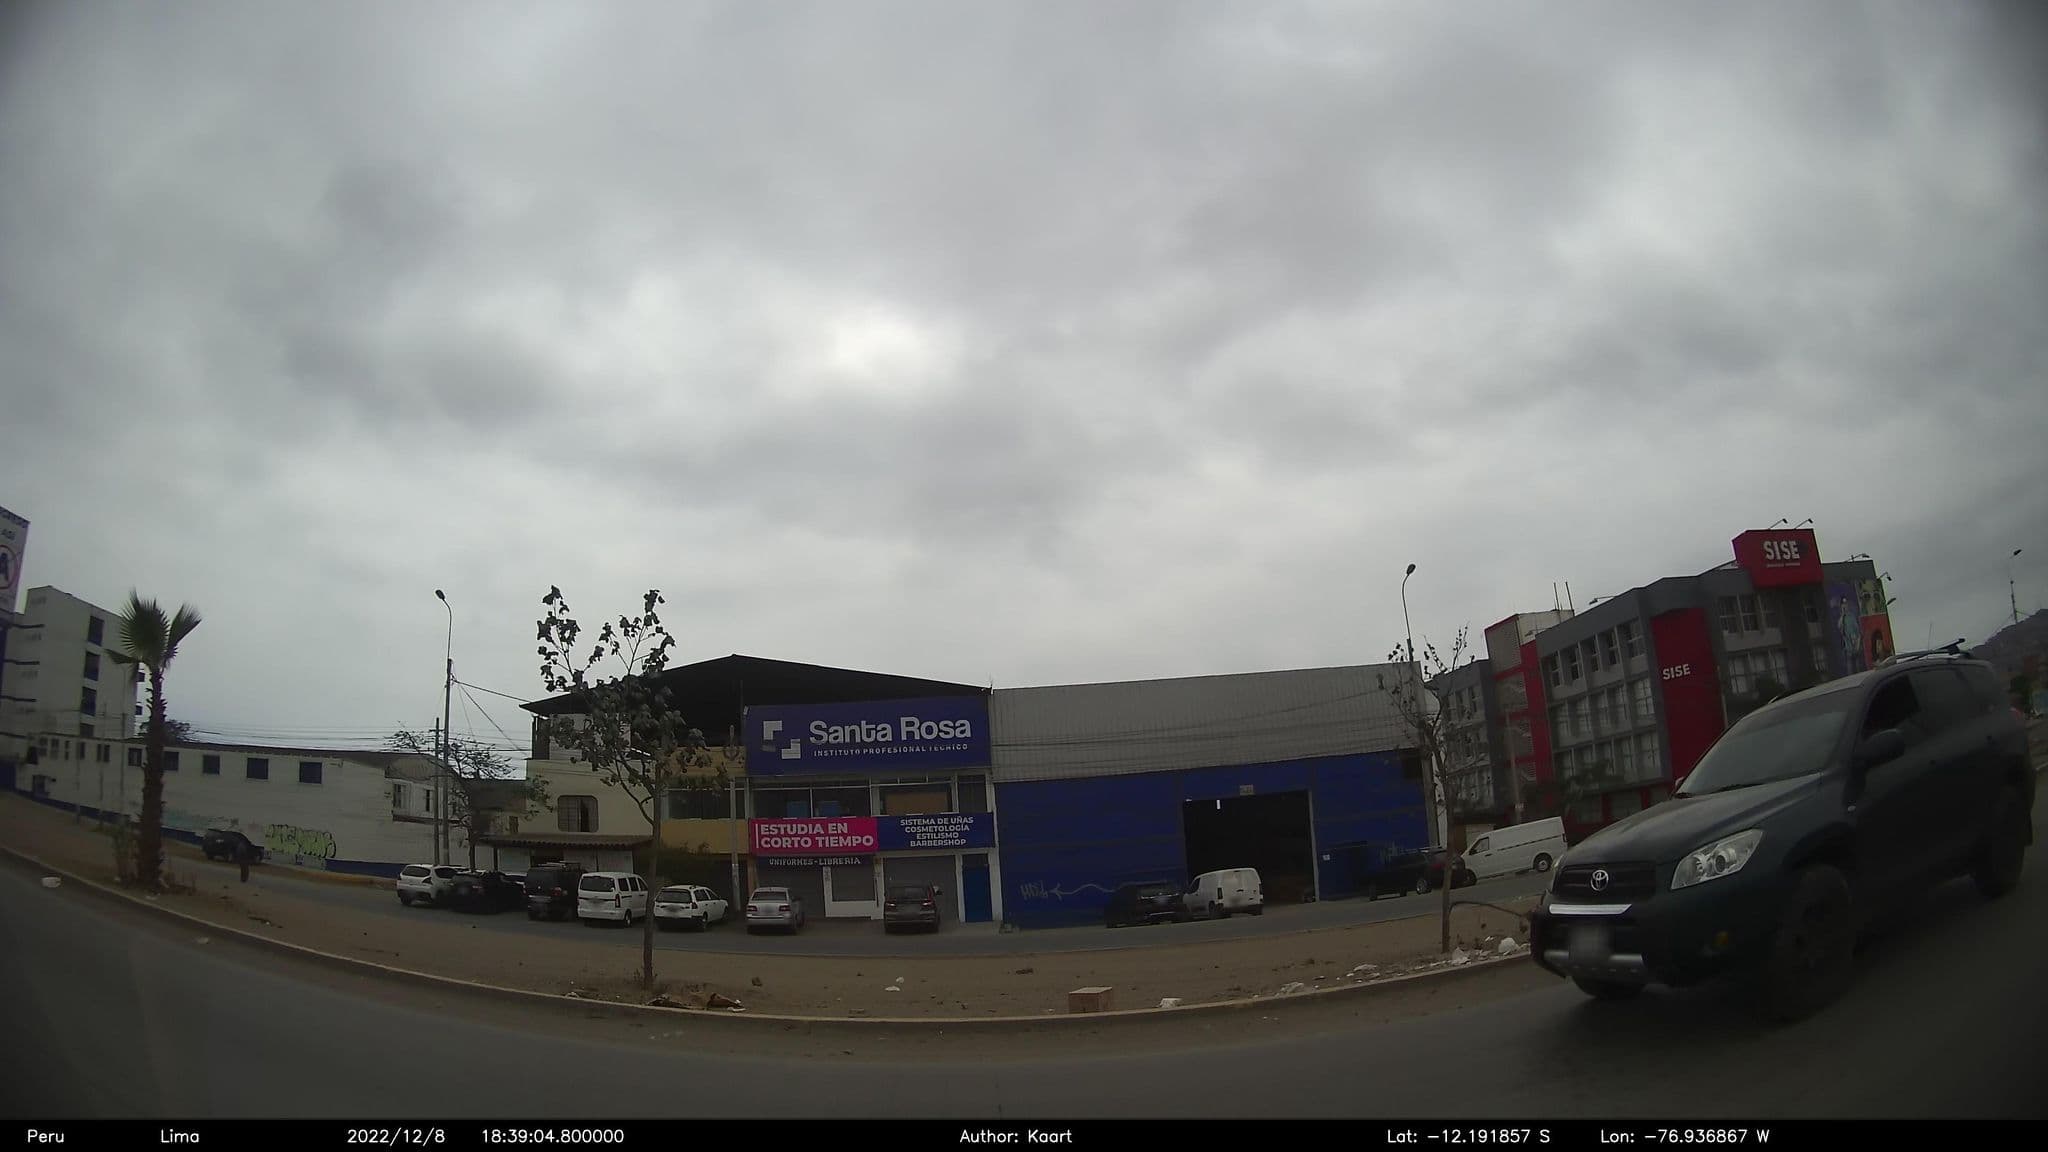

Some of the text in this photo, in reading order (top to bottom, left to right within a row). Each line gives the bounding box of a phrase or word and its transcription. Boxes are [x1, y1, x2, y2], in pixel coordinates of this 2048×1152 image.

[1763, 540, 1801, 561] SISE
[1662, 663, 1691, 681] SISE
[809, 715, 971, 745] Santa Rosa
[813, 748, 861, 757] INSTITUTO
[863, 745, 927, 754] PROFESIONAL
[899, 815, 974, 826] SISTEMA DE UÑAS
[760, 822, 848, 836] ESTUDIA EN
[916, 831, 959, 840] ESTILISMO
[760, 834, 874, 849] CORTO TIEMPO
[909, 838, 967, 847] BARBERSHOP
